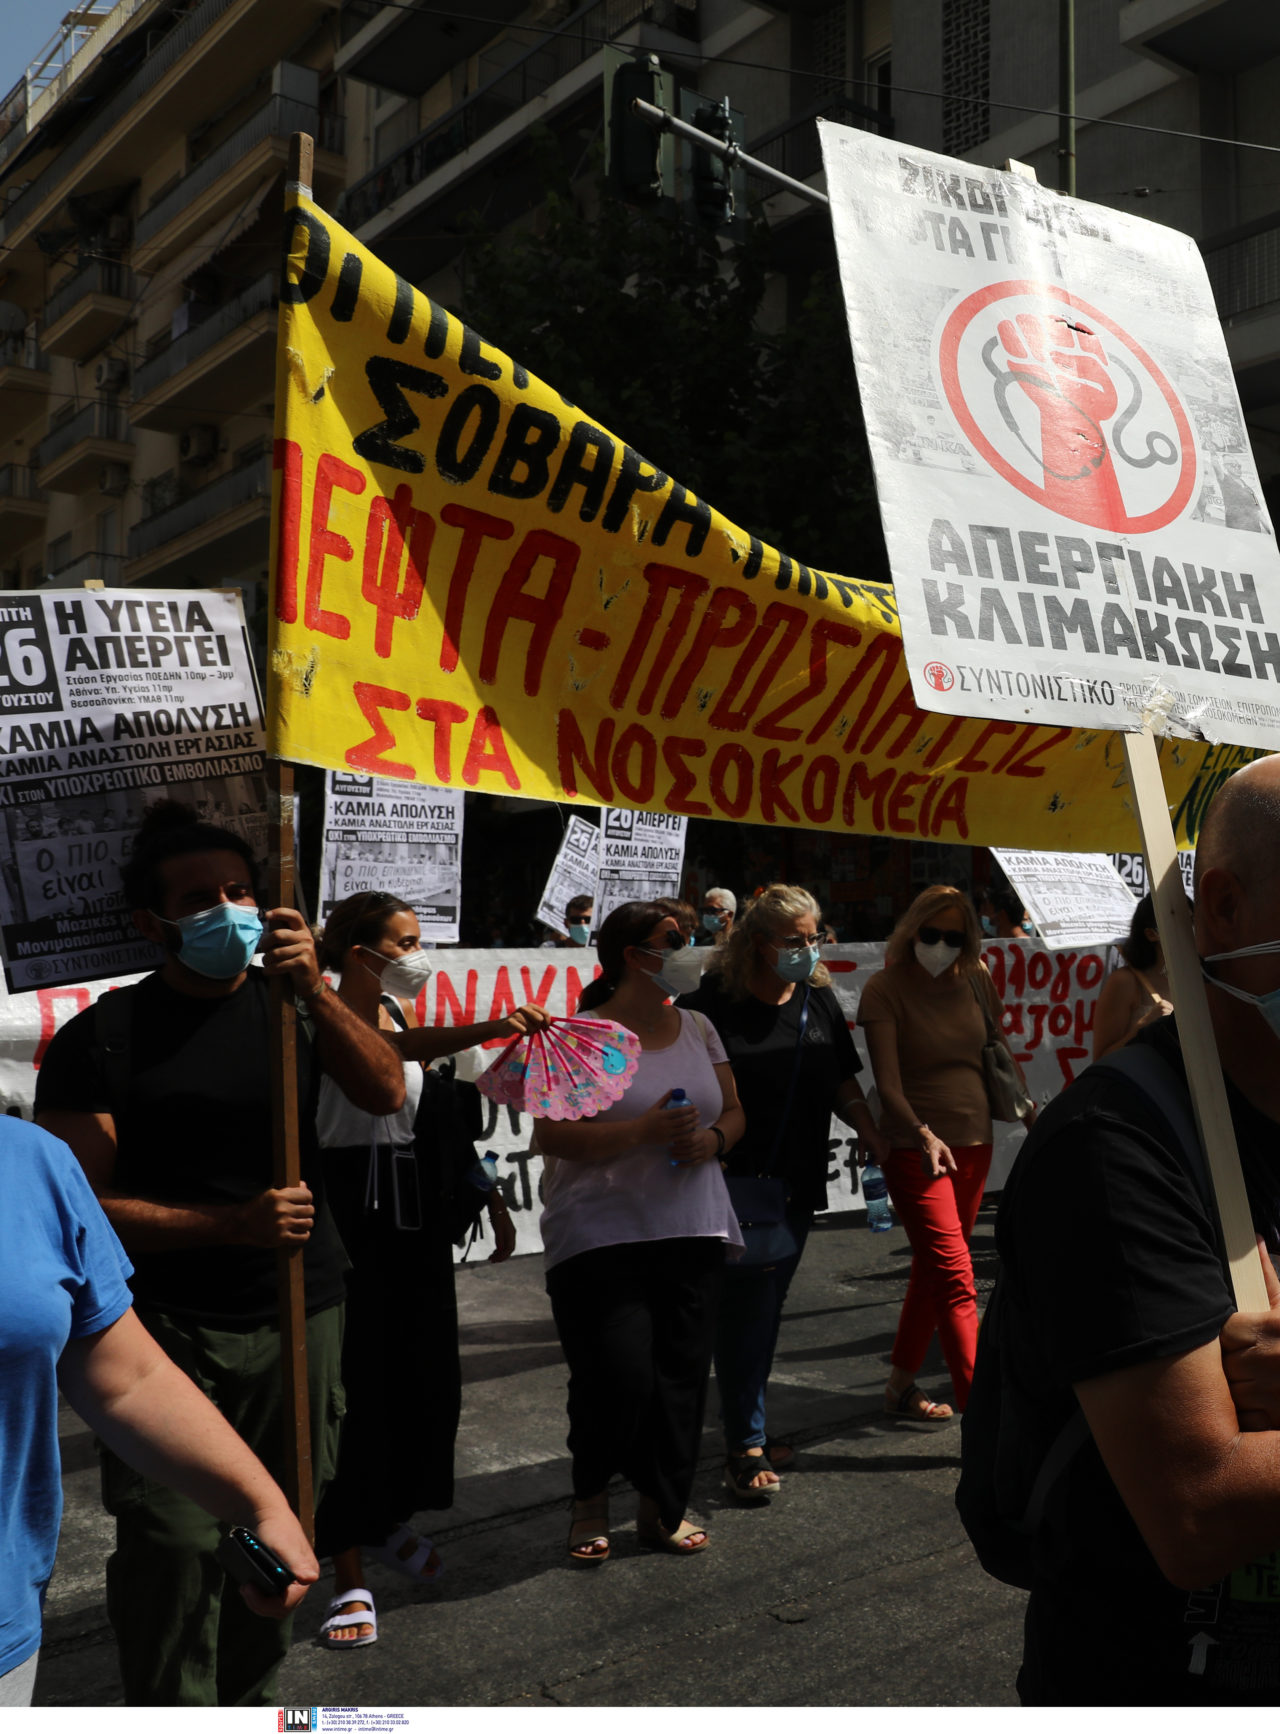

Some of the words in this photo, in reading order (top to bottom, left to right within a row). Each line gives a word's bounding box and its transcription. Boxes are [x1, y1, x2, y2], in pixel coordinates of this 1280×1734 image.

[353, 355, 712, 558] ΣΟΒΑΡΑ
[928, 518, 1264, 624] ΑΠΕΡΓΙΑΚΗ
[53, 601, 87, 634] Η
[95, 600, 214, 633] ΥΓΕΙΑ
[0, 628, 47, 686] 6
[65, 635, 231, 671] ΑΠΕΡΓΕΙ
[100, 674, 143, 686] Εργασίας
[146, 671, 182, 681] ΠΟΕΔΗΝ
[958, 666, 1114, 706] ΣΥΝΤΟΝΙΣΤΙΚΟ
[0, 691, 54, 708] ΟΥΣΤΟΥ
[113, 702, 252, 741] ΑΠΟΛΥΣΗ
[67, 740, 171, 769] ΑΝΑΣΤΟΛΗ
[175, 732, 257, 753] ΕΡΓΑΣΙΑΣ
[345, 680, 522, 791] ΣΤΑ
[554, 706, 971, 839] ΝΟΣΟΚΟΜΕΙΑ
[17, 789, 46, 803] ΣΤΟΝ
[44, 767, 161, 799] ΥΠΟΧΡΕΩΤΙΚΟ
[164, 756, 263, 783] ΕΜΒΟΛΙΑΣΜΟ
[334, 801, 386, 816] ΚΑΜΙΑ
[391, 803, 455, 820] ΑΠΟΛΥΣΗ
[334, 818, 366, 827] ΚΑΜΙΑ
[369, 819, 414, 830] ΑΝΑΣΤΟΛΗ
[417, 822, 455, 831] ΕΡΓΑΣΙΑΣ
[636, 811, 681, 831] ΑΠΕΡΓΕΙ
[570, 827, 590, 850] 26
[605, 843, 638, 858] ΚΑΜΙΑ
[641, 845, 680, 861] ΑΠΟΛΥΣΗ
[1004, 855, 1054, 867] ΚΑΜΙΑ
[1120, 855, 1143, 884] 26
[53, 943, 157, 974] ΣΥΝΤΟΝΙΣΤΙΚΟ
